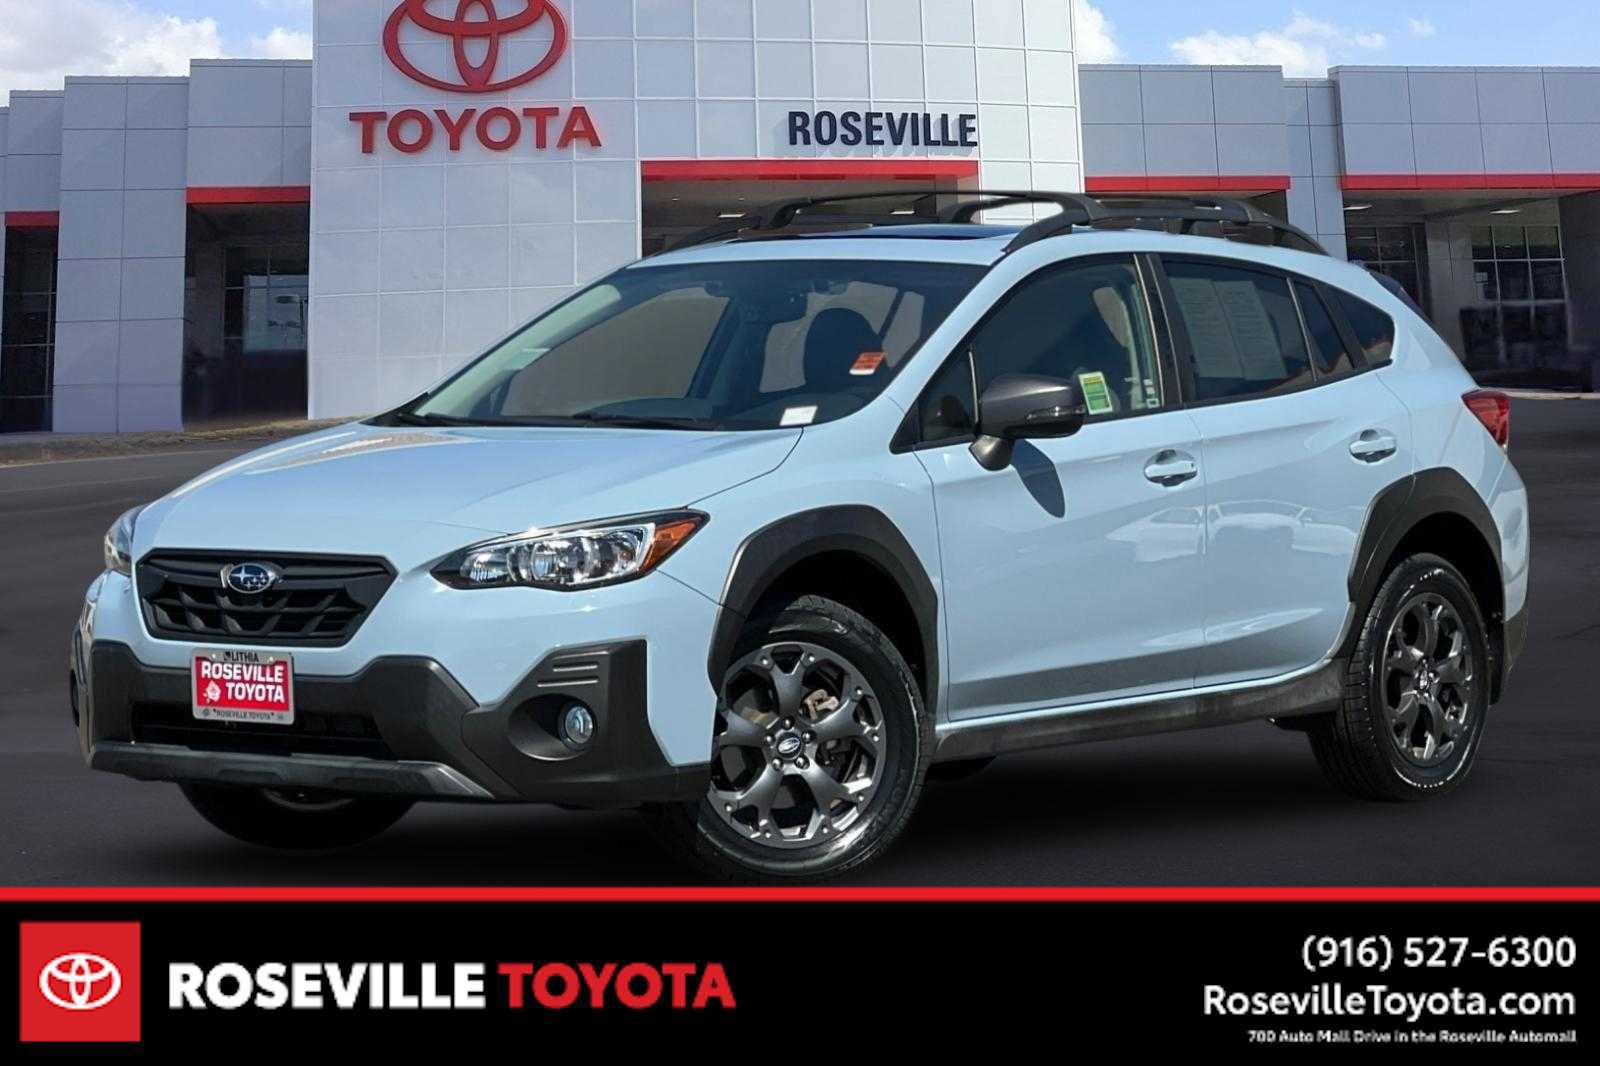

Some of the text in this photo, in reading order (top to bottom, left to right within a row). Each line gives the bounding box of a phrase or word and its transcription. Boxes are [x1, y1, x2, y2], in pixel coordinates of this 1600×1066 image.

[349, 106, 602, 154] TOYOTA
[788, 110, 979, 147] ROSEVILLE
[231, 651, 259, 662] LITHIA
[201, 661, 284, 683] ROSEVILLE
[225, 682, 285, 703] TOYOTA
